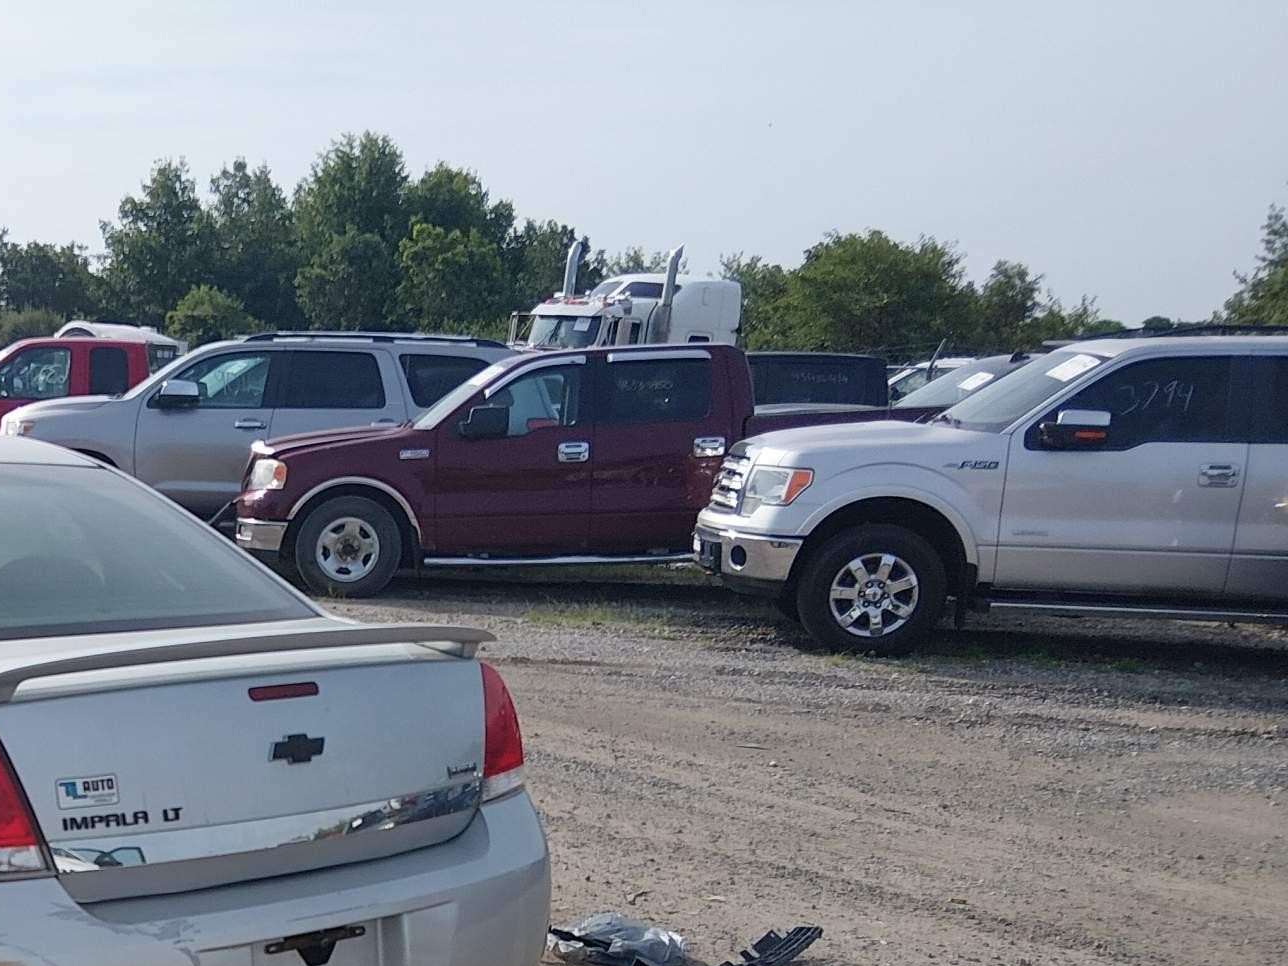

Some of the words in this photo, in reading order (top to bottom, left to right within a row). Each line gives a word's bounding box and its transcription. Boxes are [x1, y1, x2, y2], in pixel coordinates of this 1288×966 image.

[82, 778, 114, 792] AUTO
[62, 810, 149, 831] IMPALA
[162, 807, 183, 822] LT
